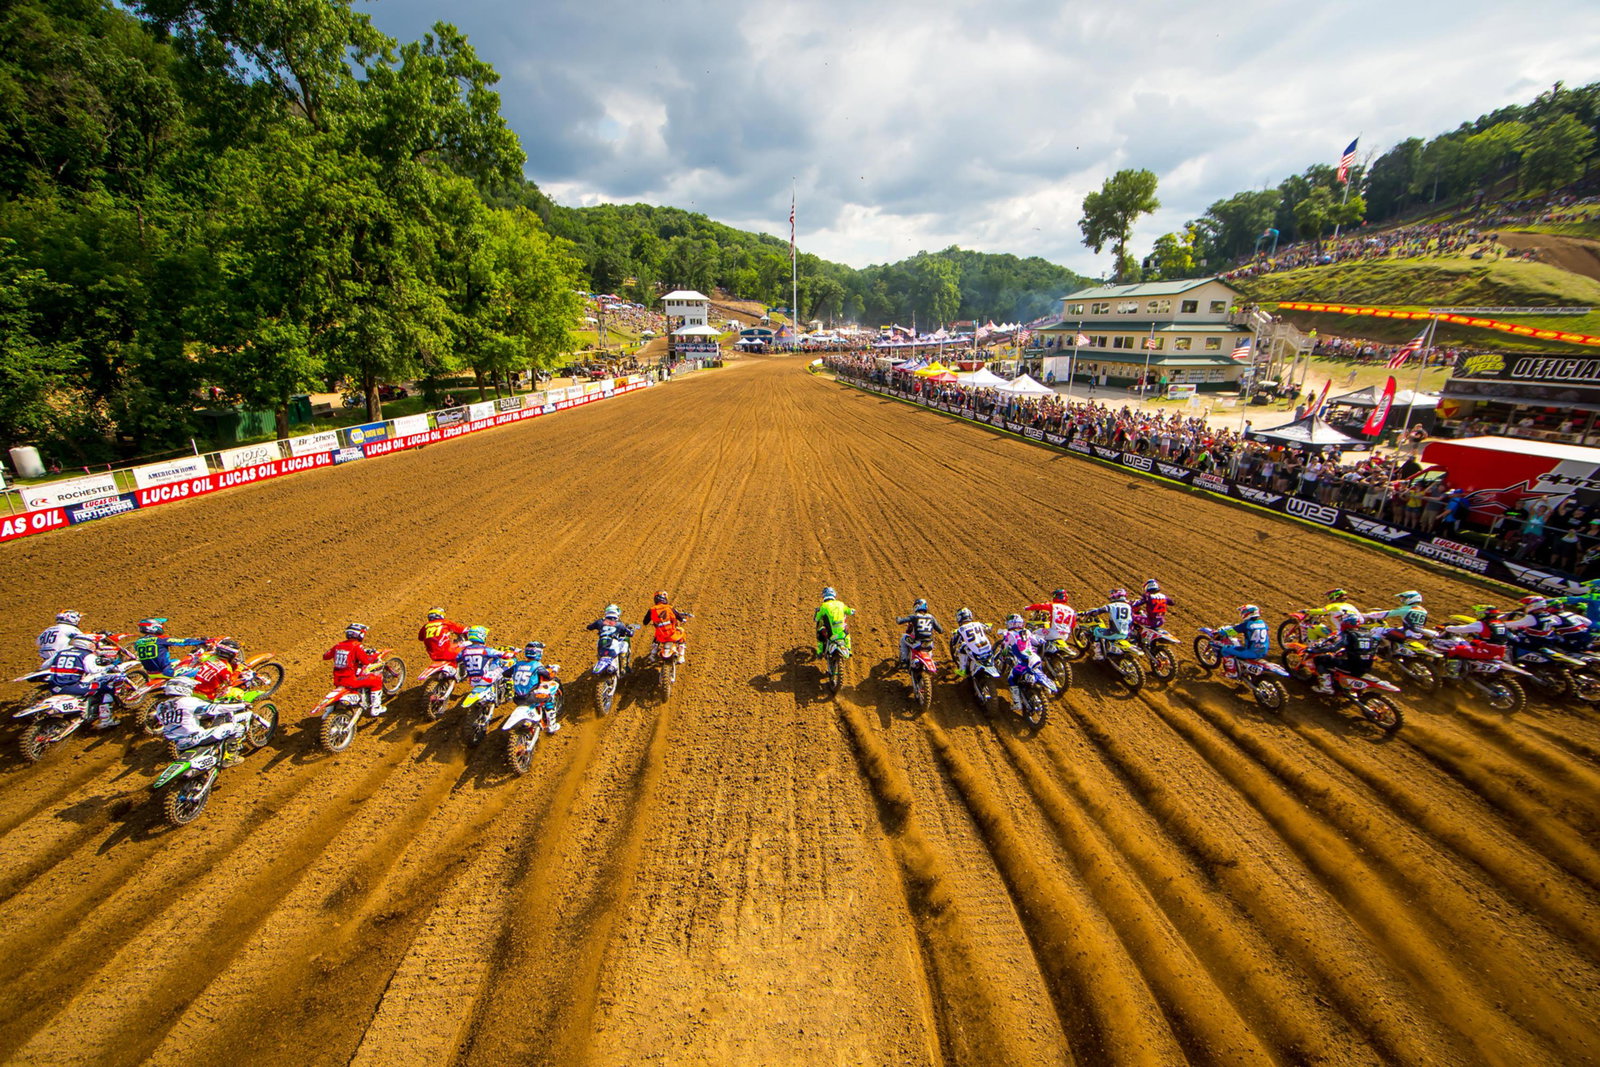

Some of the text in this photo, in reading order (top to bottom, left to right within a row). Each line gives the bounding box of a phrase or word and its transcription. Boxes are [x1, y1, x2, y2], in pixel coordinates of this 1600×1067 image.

[1463, 354, 1504, 369] MOTO
[1467, 361, 1506, 375] TEES
[443, 423, 471, 437] LUCAS OIL
[471, 419, 487, 430] LUCAS
[487, 417, 495, 427] OIL
[407, 430, 441, 446] LUCAS OIL
[1024, 426, 1044, 440] WPS
[1045, 432, 1066, 444] FLY
[366, 442, 392, 455] LUCAS
[393, 439, 405, 448] OIL
[1094, 445, 1120, 460] FLY
[233, 447, 267, 466] MOTO
[281, 456, 314, 472] LUCAS
[316, 453, 331, 465] OIL
[1123, 452, 1153, 471] WPS
[147, 468, 180, 480] AMERICAN
[180, 465, 197, 474] HOME
[219, 463, 278, 487] LUCAS OIL
[1156, 462, 1190, 478] FLY
[57, 484, 114, 501] ROCHESTER
[142, 478, 214, 505] LUCAS OIL
[1193, 478, 1228, 493] MOTOCROSS
[1235, 484, 1282, 503] FLY
[84, 495, 118, 508] LUCAS OIL
[74, 501, 134, 522] MOTOCROSS
[1286, 497, 1338, 525] WPS
[32, 510, 63, 529] OIL
[1345, 514, 1411, 539] FLY
[1433, 538, 1476, 556] LUCAS OIL
[1414, 543, 1488, 571] MOTOCROSS
[1503, 560, 1591, 595] FLY
[1116, 607, 1129, 620] 19
[1152, 599, 1167, 613] 25
[658, 610, 667, 620] 4
[1055, 611, 1073, 626] 34
[1408, 612, 1426, 625] 46
[425, 625, 443, 638] 121
[600, 626, 617, 637] 2
[917, 619, 933, 632] 94
[965, 626, 983, 642] 54
[1250, 629, 1267, 643] 49
[138, 644, 156, 659] 89
[57, 656, 75, 669] 86
[464, 655, 483, 671] 39
[1482, 663, 1493, 671] 57
[514, 671, 533, 686] 95
[62, 703, 74, 711] 86
